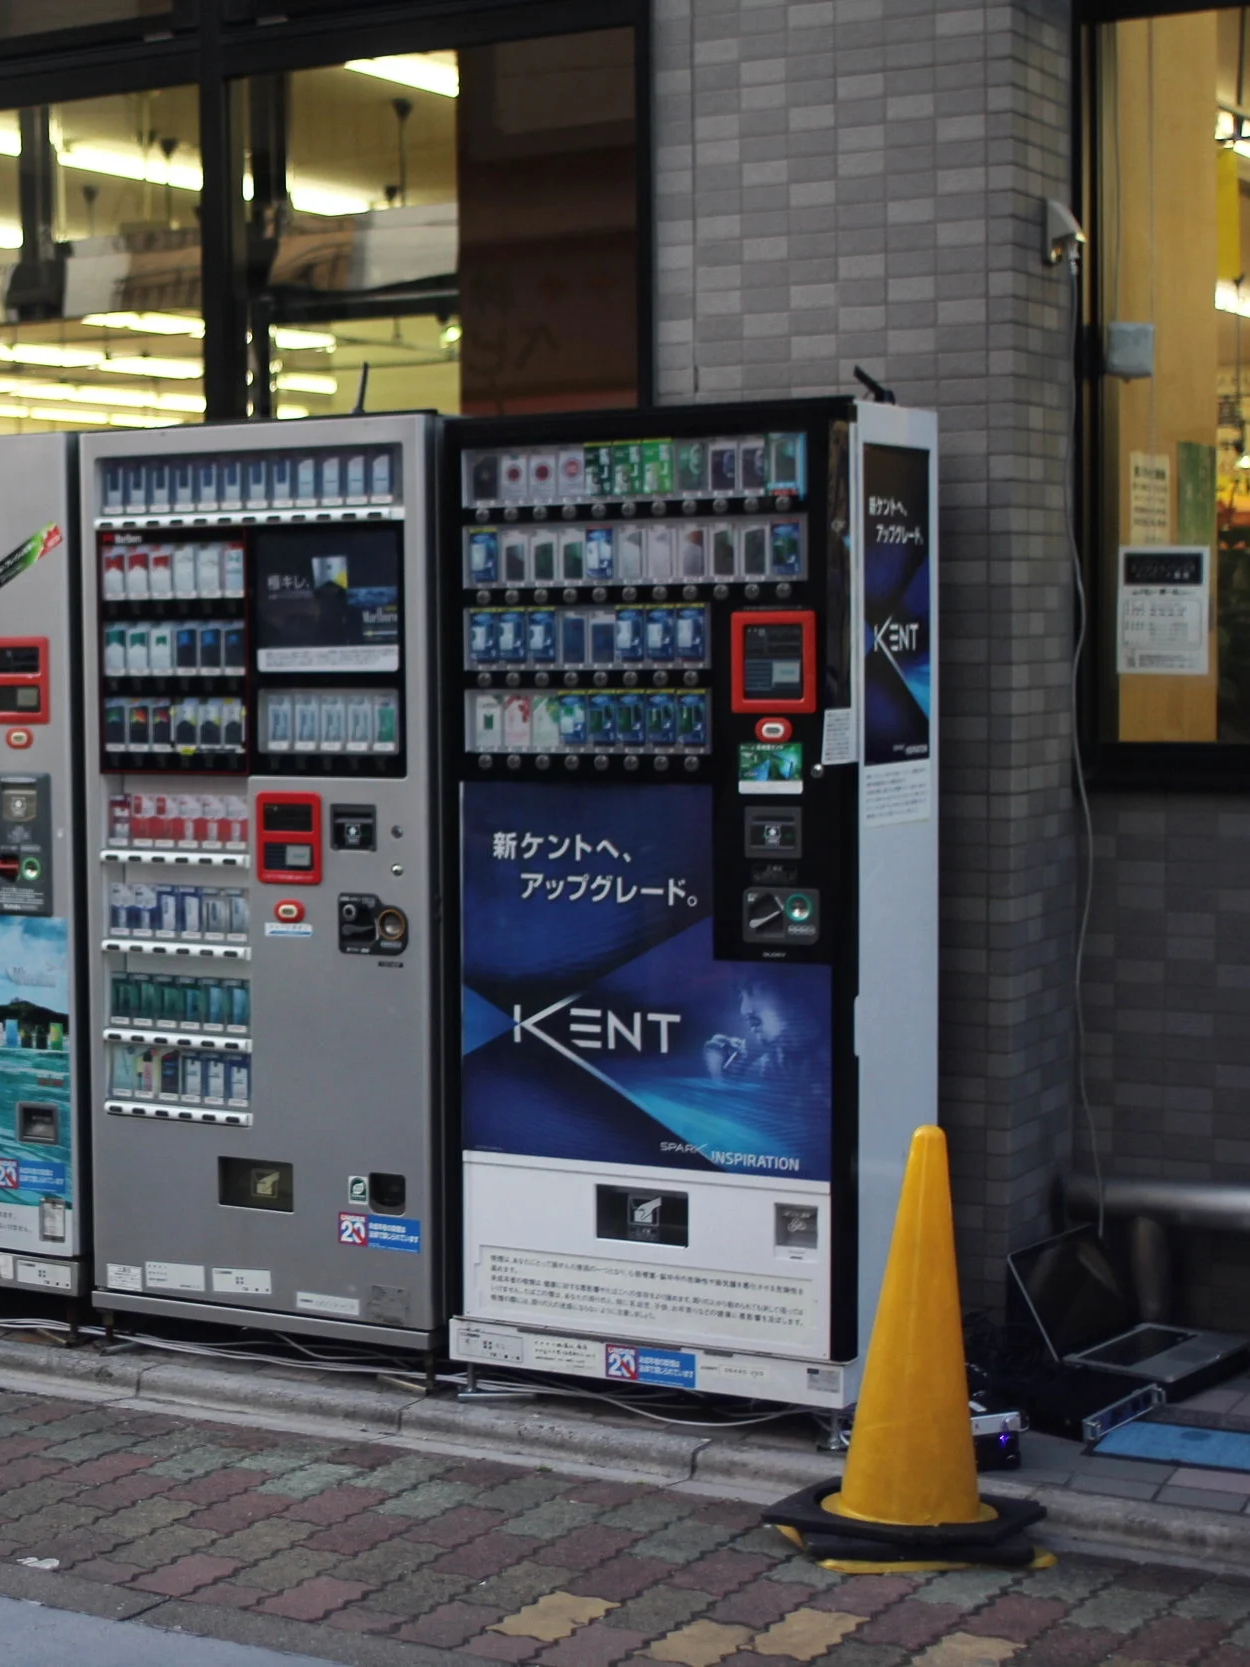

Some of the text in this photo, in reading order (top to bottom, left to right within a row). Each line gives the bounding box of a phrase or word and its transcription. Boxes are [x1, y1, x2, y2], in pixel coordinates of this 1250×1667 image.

[873, 616, 919, 652] KENT
[492, 832, 632, 862] 新ケントへ、
[520, 872, 698, 908] アップグレード。
[514, 995, 681, 1054] KENT
[659, 1141, 708, 1154] SPARK
[710, 1150, 800, 1171] INSPIRATION
[340, 1220, 366, 1244] 20
[607, 1354, 636, 1378] 20
